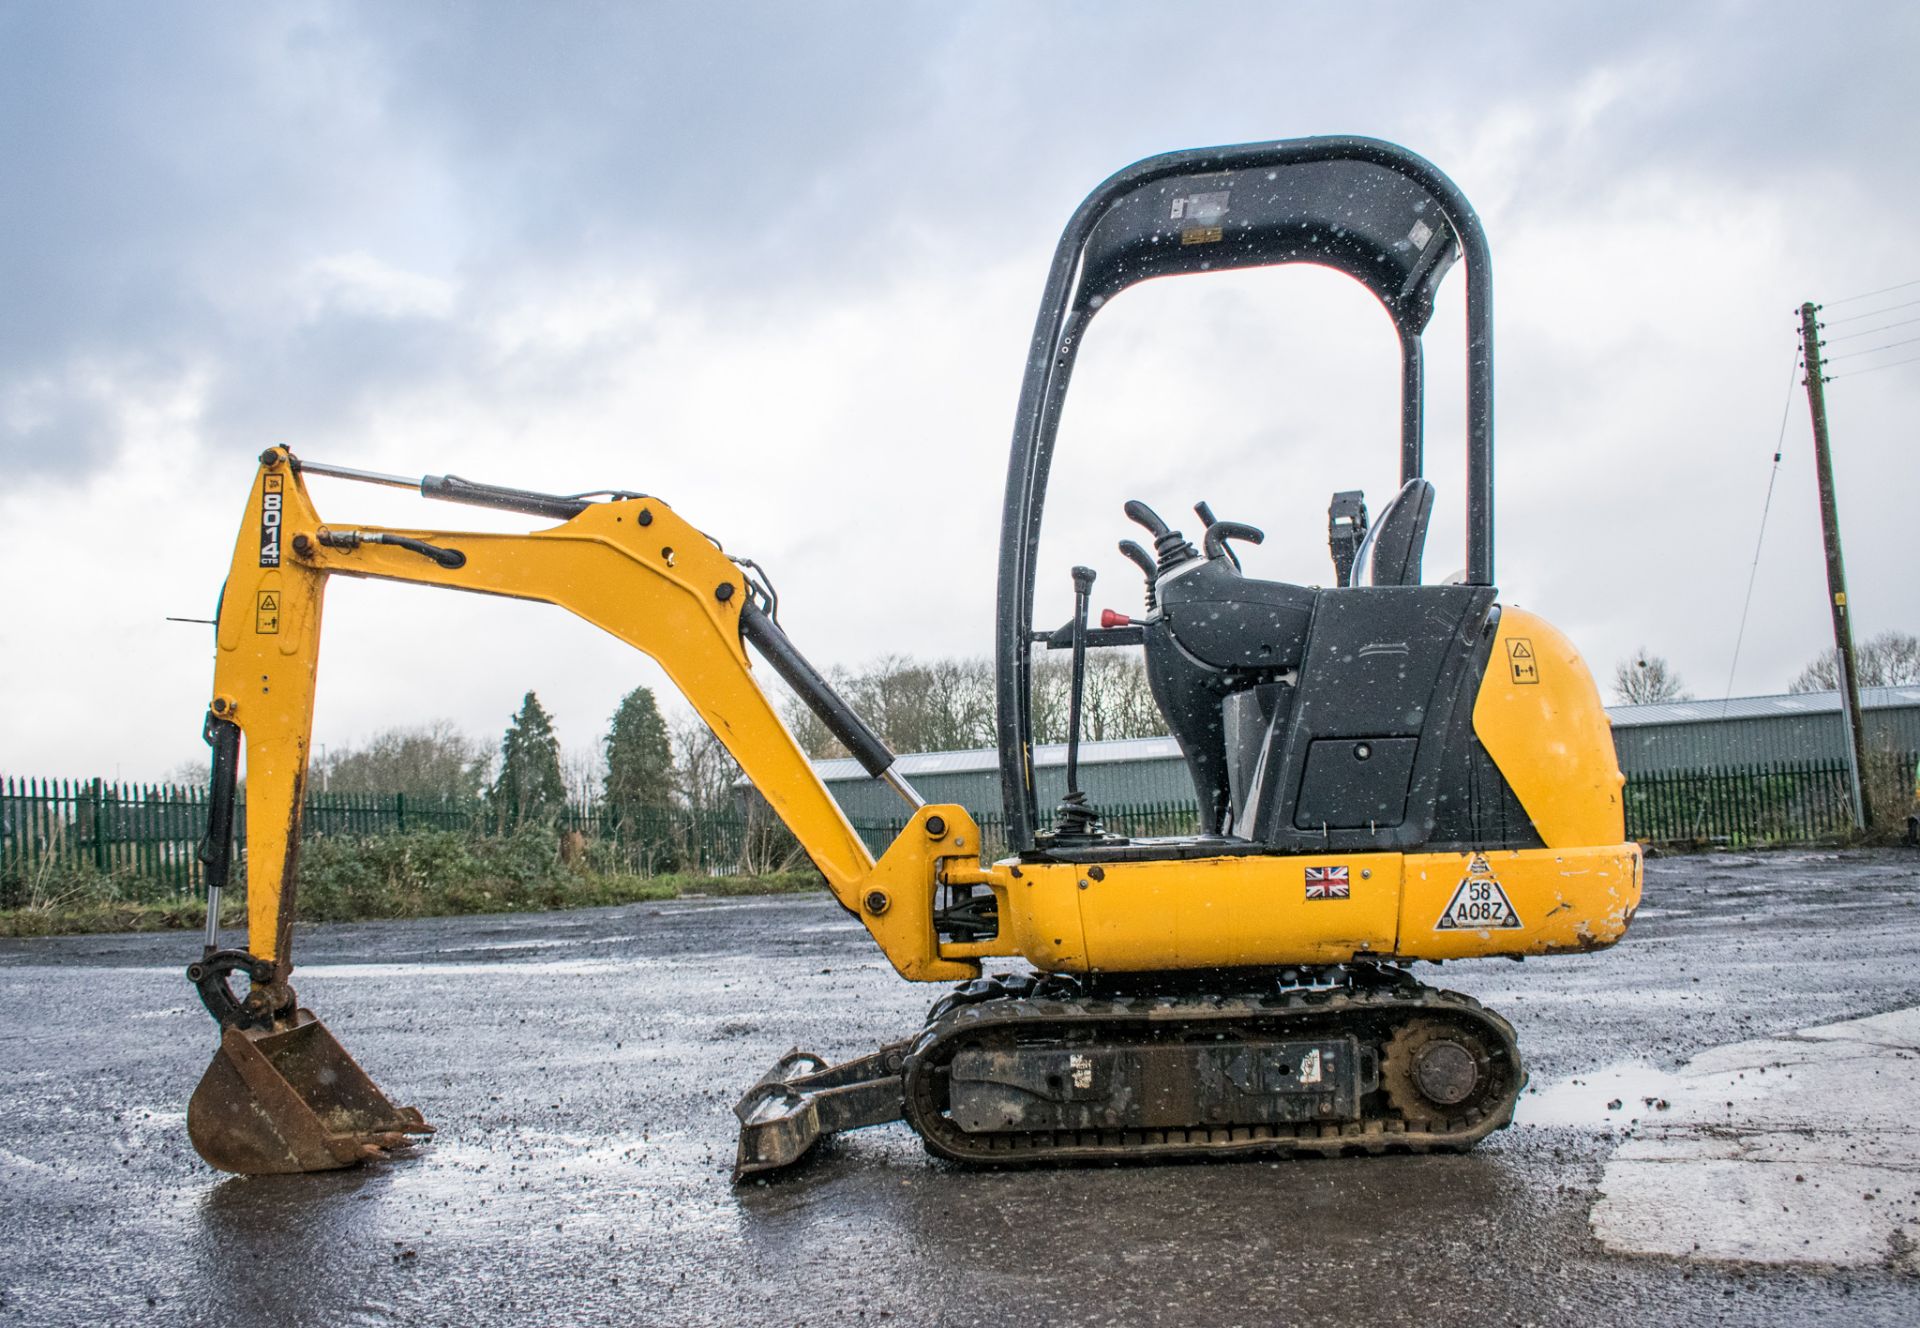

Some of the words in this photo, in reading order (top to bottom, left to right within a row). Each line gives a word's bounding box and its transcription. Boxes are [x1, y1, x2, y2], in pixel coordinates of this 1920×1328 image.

[261, 494, 281, 558] 8014
[1469, 882, 1491, 901] 58
[1457, 902, 1503, 921] A08Z
